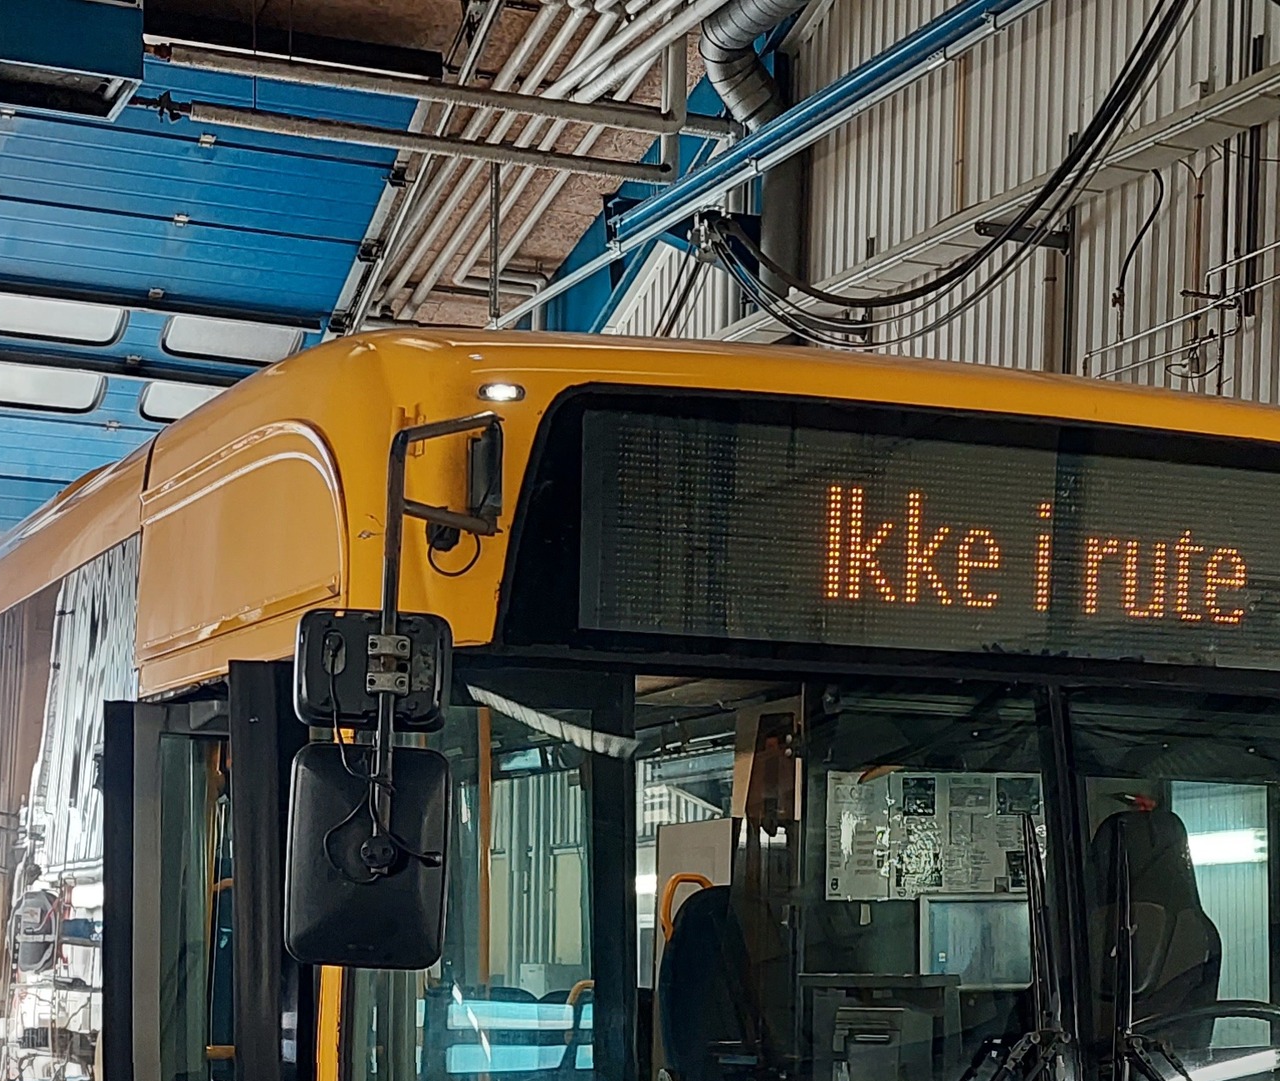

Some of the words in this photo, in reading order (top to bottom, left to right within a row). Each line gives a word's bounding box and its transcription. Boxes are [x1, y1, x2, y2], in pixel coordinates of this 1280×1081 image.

[826, 485, 1000, 606] Ikke
[1033, 502, 1052, 612] i
[1083, 529, 1247, 623] rute
